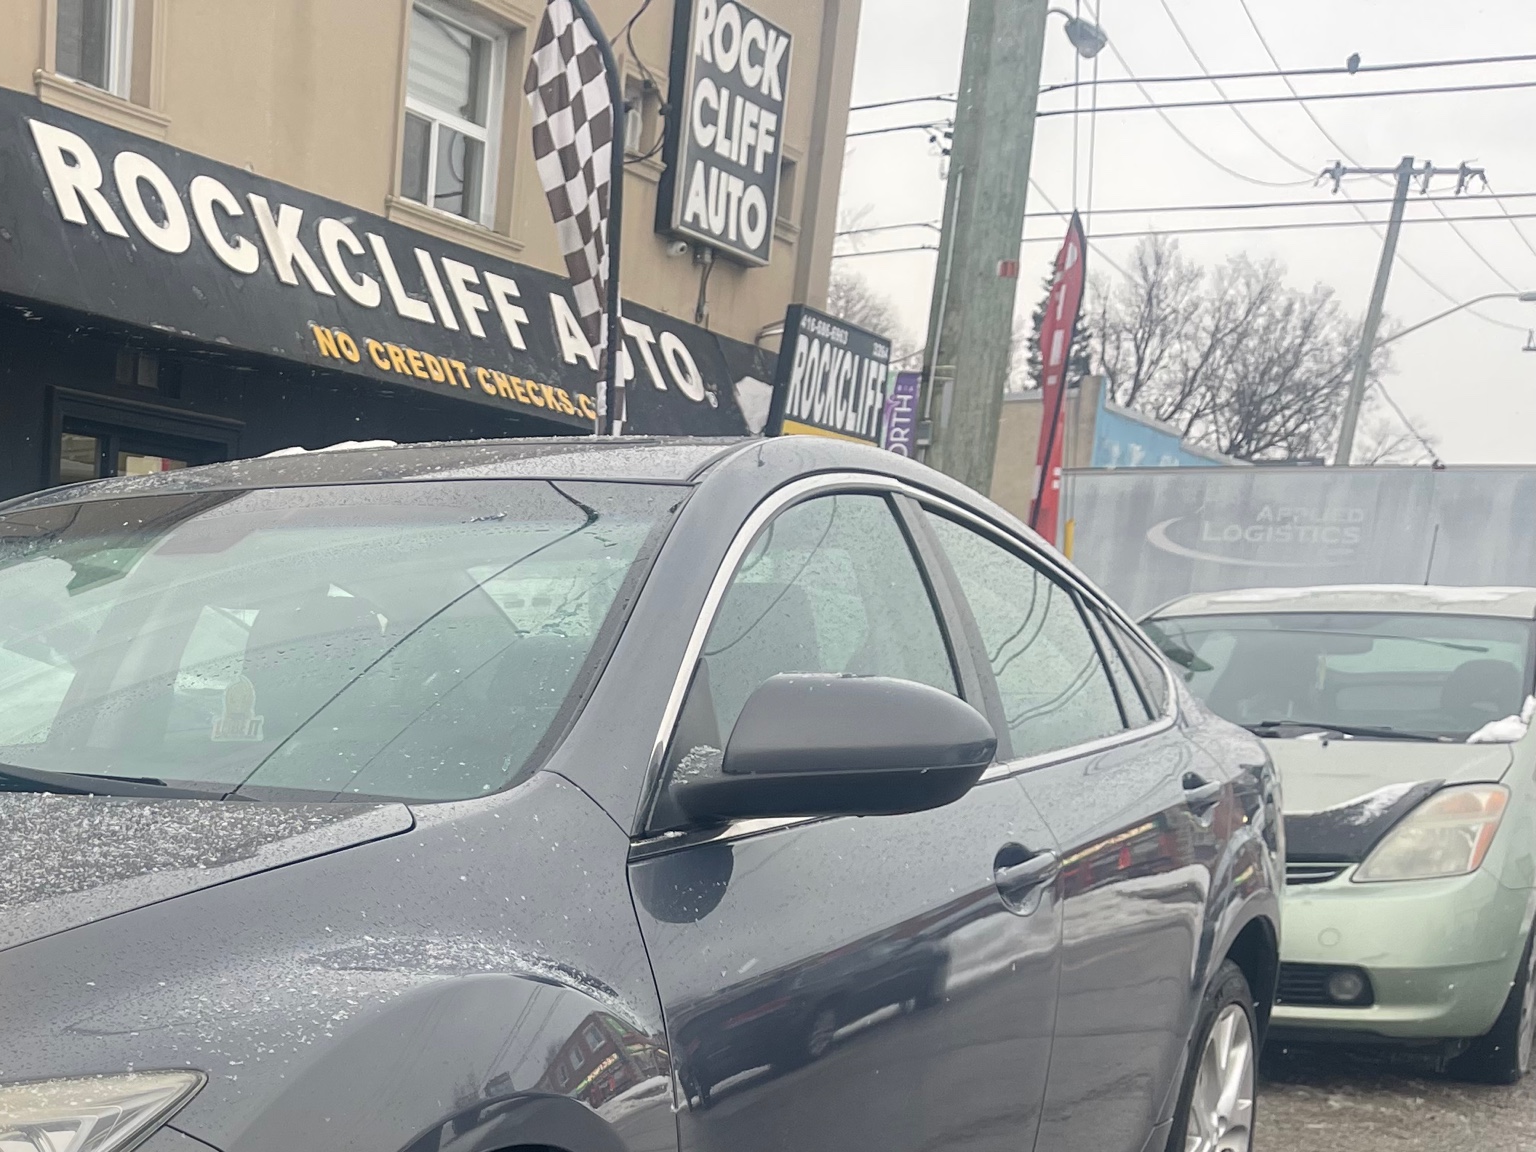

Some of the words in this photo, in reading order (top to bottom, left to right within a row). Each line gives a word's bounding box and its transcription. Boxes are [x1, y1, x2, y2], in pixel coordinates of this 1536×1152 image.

[695, 0, 789, 102] ROCK
[692, 77, 778, 175] CLIFF
[683, 159, 768, 251] AUTO
[28, 118, 529, 351] ROCKCLIFF
[549, 292, 704, 402] ATO
[310, 322, 361, 364] NO
[365, 338, 471, 389] CREDIT
[785, 333, 887, 438] ROCKCLIFF
[1202, 519, 1361, 545] LOGISTICS
